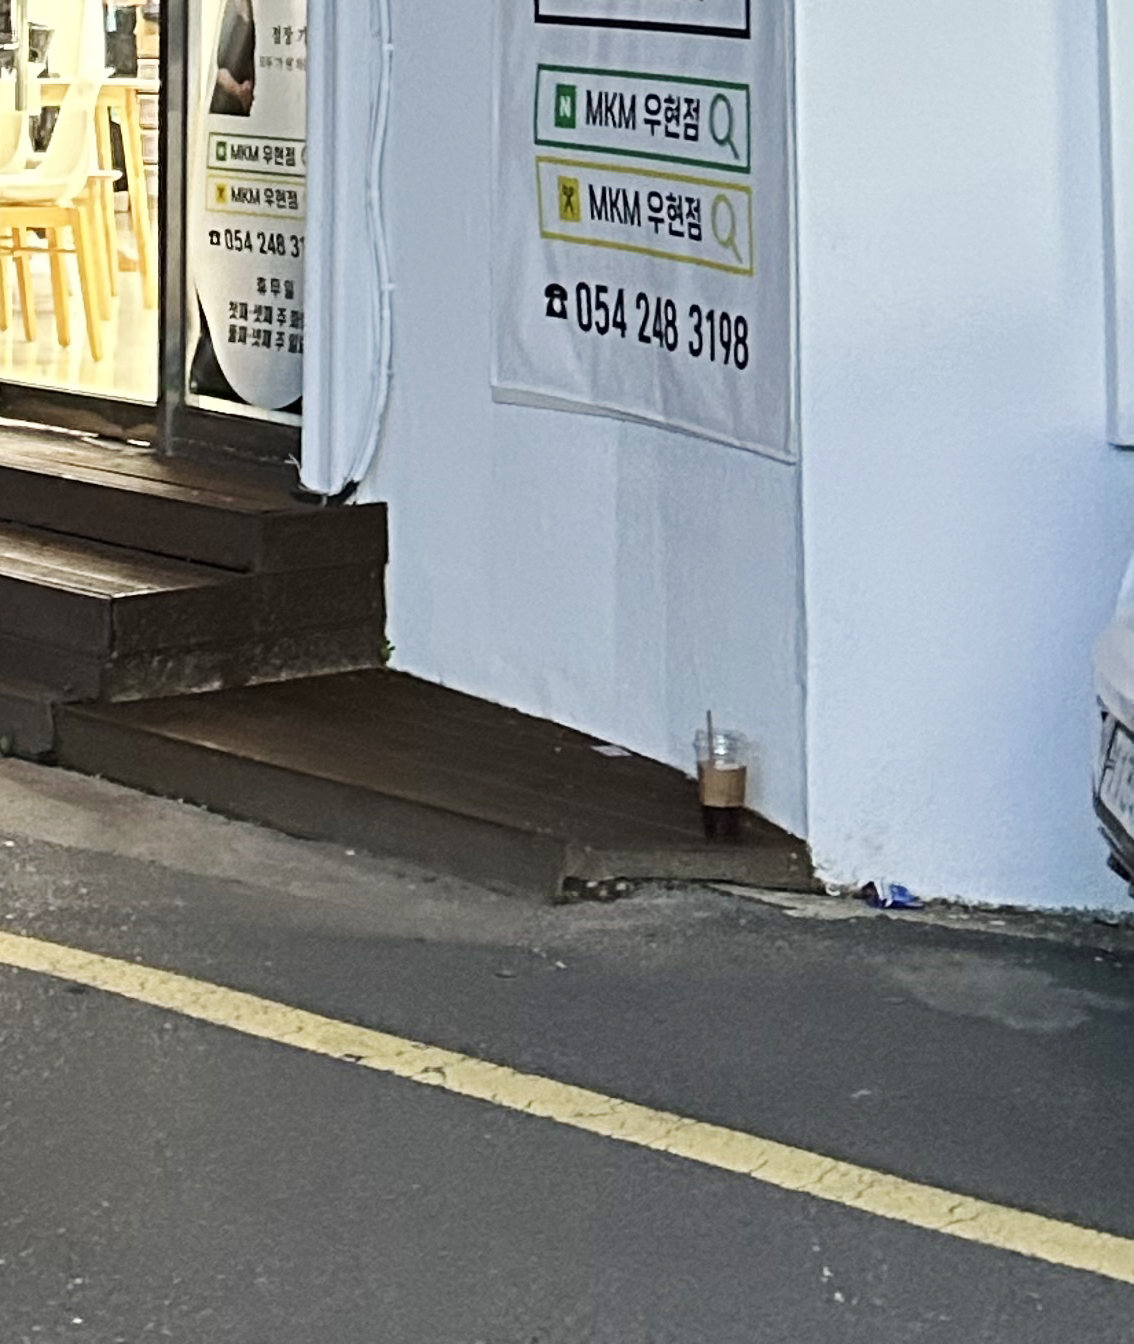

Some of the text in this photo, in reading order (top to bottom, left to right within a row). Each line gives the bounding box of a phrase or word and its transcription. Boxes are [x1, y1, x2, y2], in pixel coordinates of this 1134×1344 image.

[585, 90, 637, 130] MKM
[643, 94, 701, 142] 우현점
[230, 144, 259, 162] MKM
[231, 186, 260, 206] MKM
[588, 184, 703, 242] MKM 우현점
[224, 228, 253, 253] 054
[257, 231, 286, 257] 248
[575, 281, 749, 370] 054 248 3198
